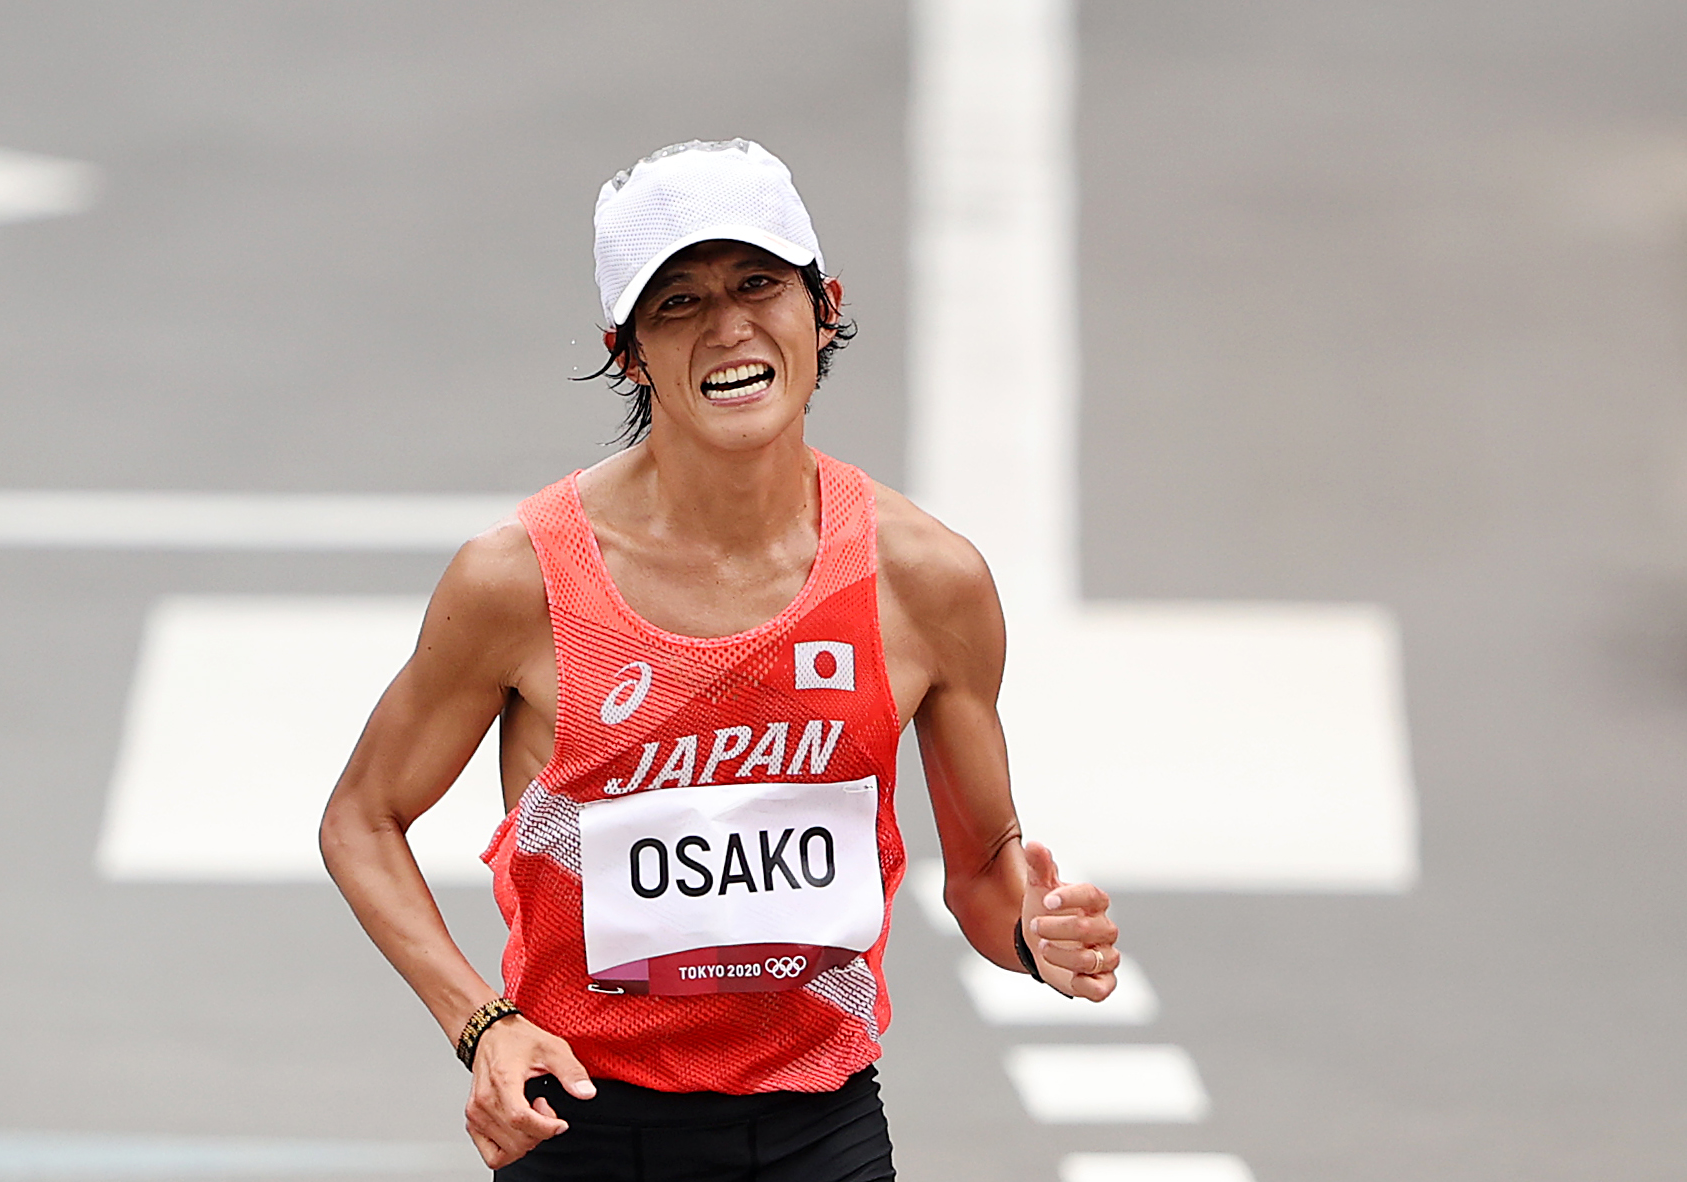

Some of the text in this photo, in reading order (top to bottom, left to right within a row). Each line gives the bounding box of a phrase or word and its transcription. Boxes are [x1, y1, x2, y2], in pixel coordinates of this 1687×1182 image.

[603, 720, 845, 794] JAPAN
[629, 826, 836, 899] OSAKO
[678, 963, 761, 980] TOKYO 2020
